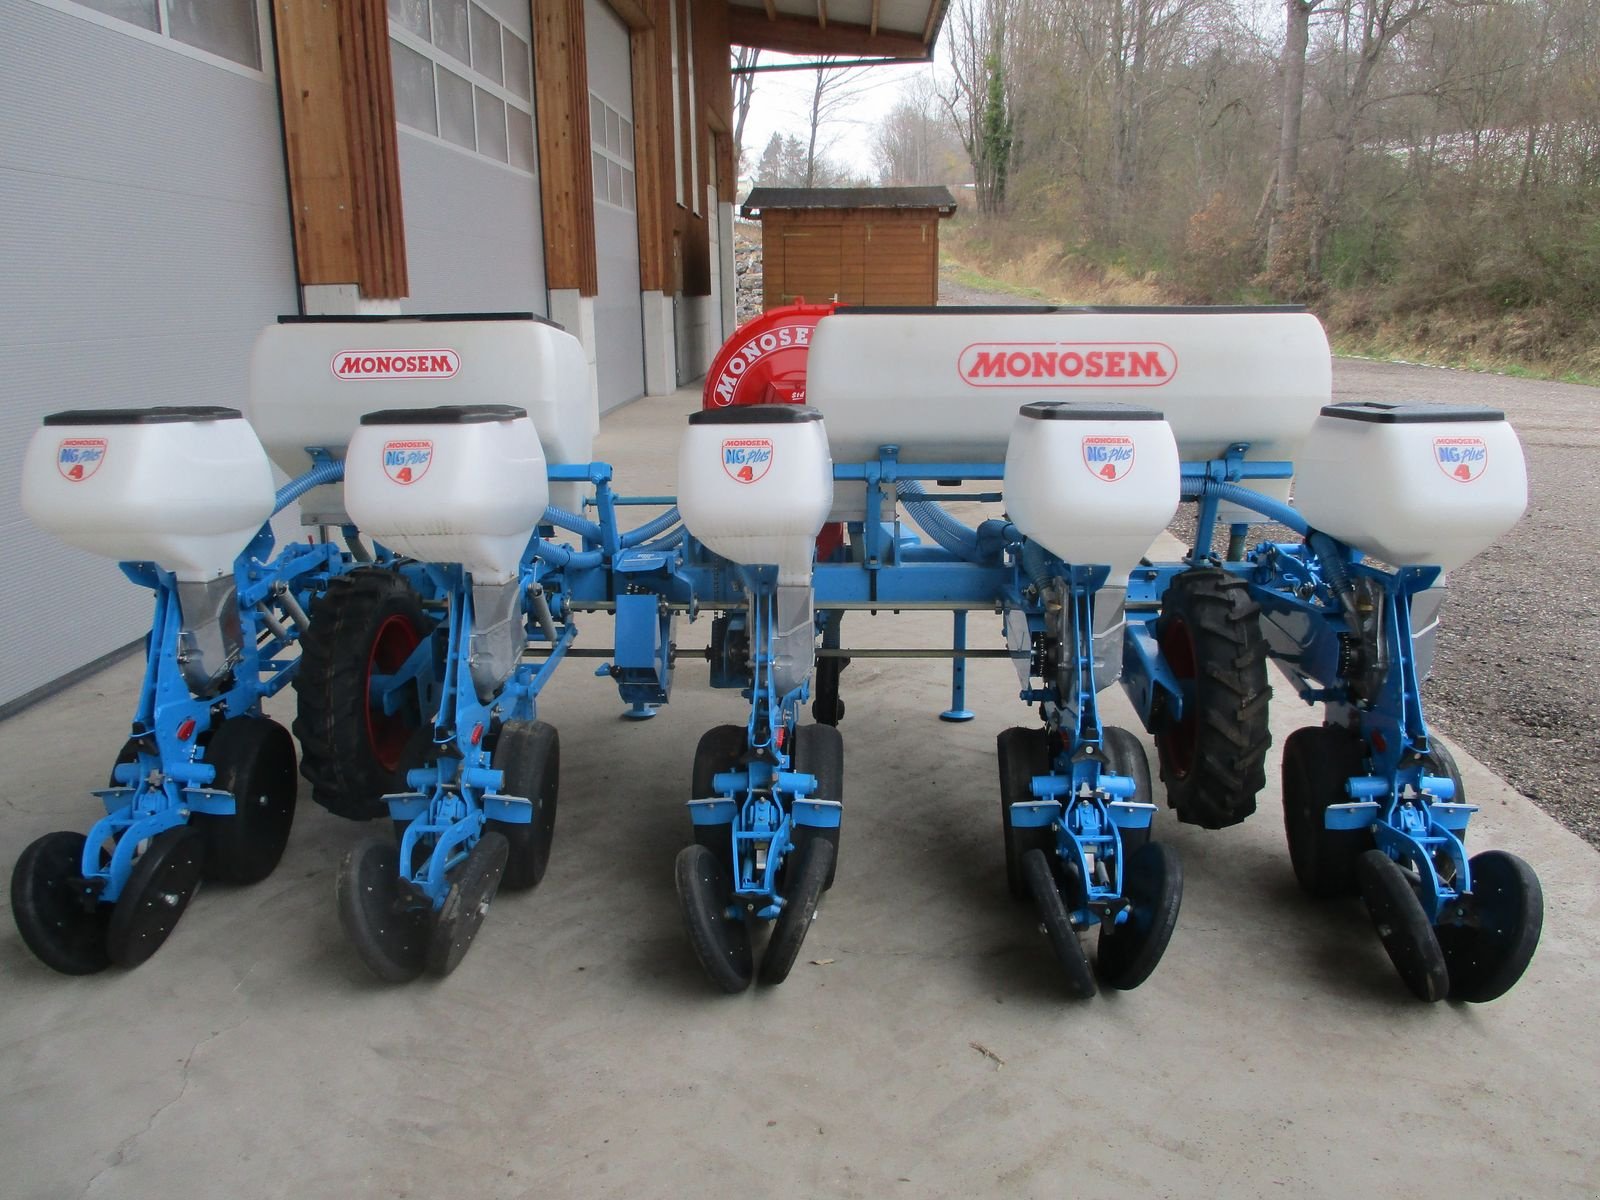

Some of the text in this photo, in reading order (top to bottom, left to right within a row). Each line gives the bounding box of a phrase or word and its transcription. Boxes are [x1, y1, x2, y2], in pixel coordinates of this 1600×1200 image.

[339, 355, 453, 374] MONOSEM
[716, 327, 816, 402] MONOSE
[967, 351, 1167, 378] MONOSEM
[385, 450, 405, 466] NG
[725, 448, 745, 464] NG
[1087, 446, 1107, 462] NG
[1438, 447, 1460, 463] NG
[68, 464, 84, 479] 4
[396, 467, 412, 482] 4
[737, 465, 753, 481] 4
[1099, 463, 1116, 479] 4
[1454, 463, 1471, 480] 4
